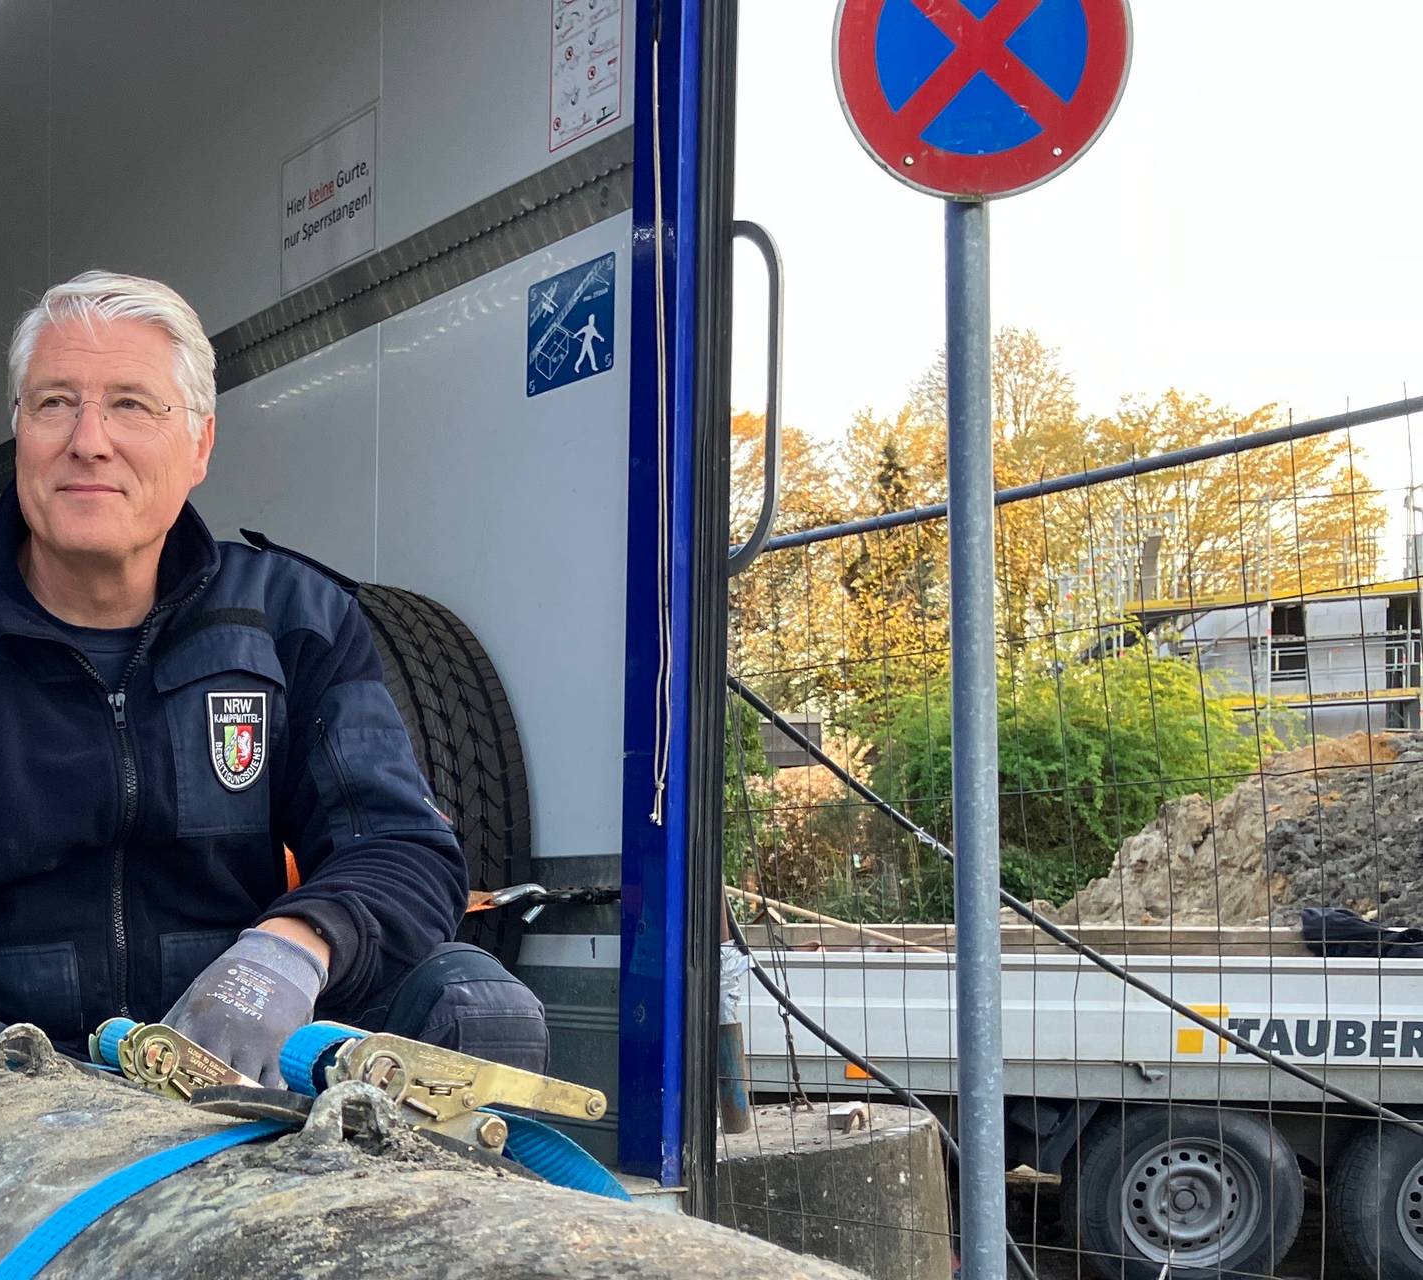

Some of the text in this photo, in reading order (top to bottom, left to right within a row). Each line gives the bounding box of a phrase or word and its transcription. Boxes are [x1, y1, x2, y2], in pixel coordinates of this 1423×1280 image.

[286, 161, 370, 218] Hier keine Gurte,
[283, 186, 372, 250] nur Sperrstangen!
[214, 713, 263, 724] KAMPFMITTEL-
[223, 698, 253, 714] NRW
[1227, 1018, 1423, 1058] TAUBER
